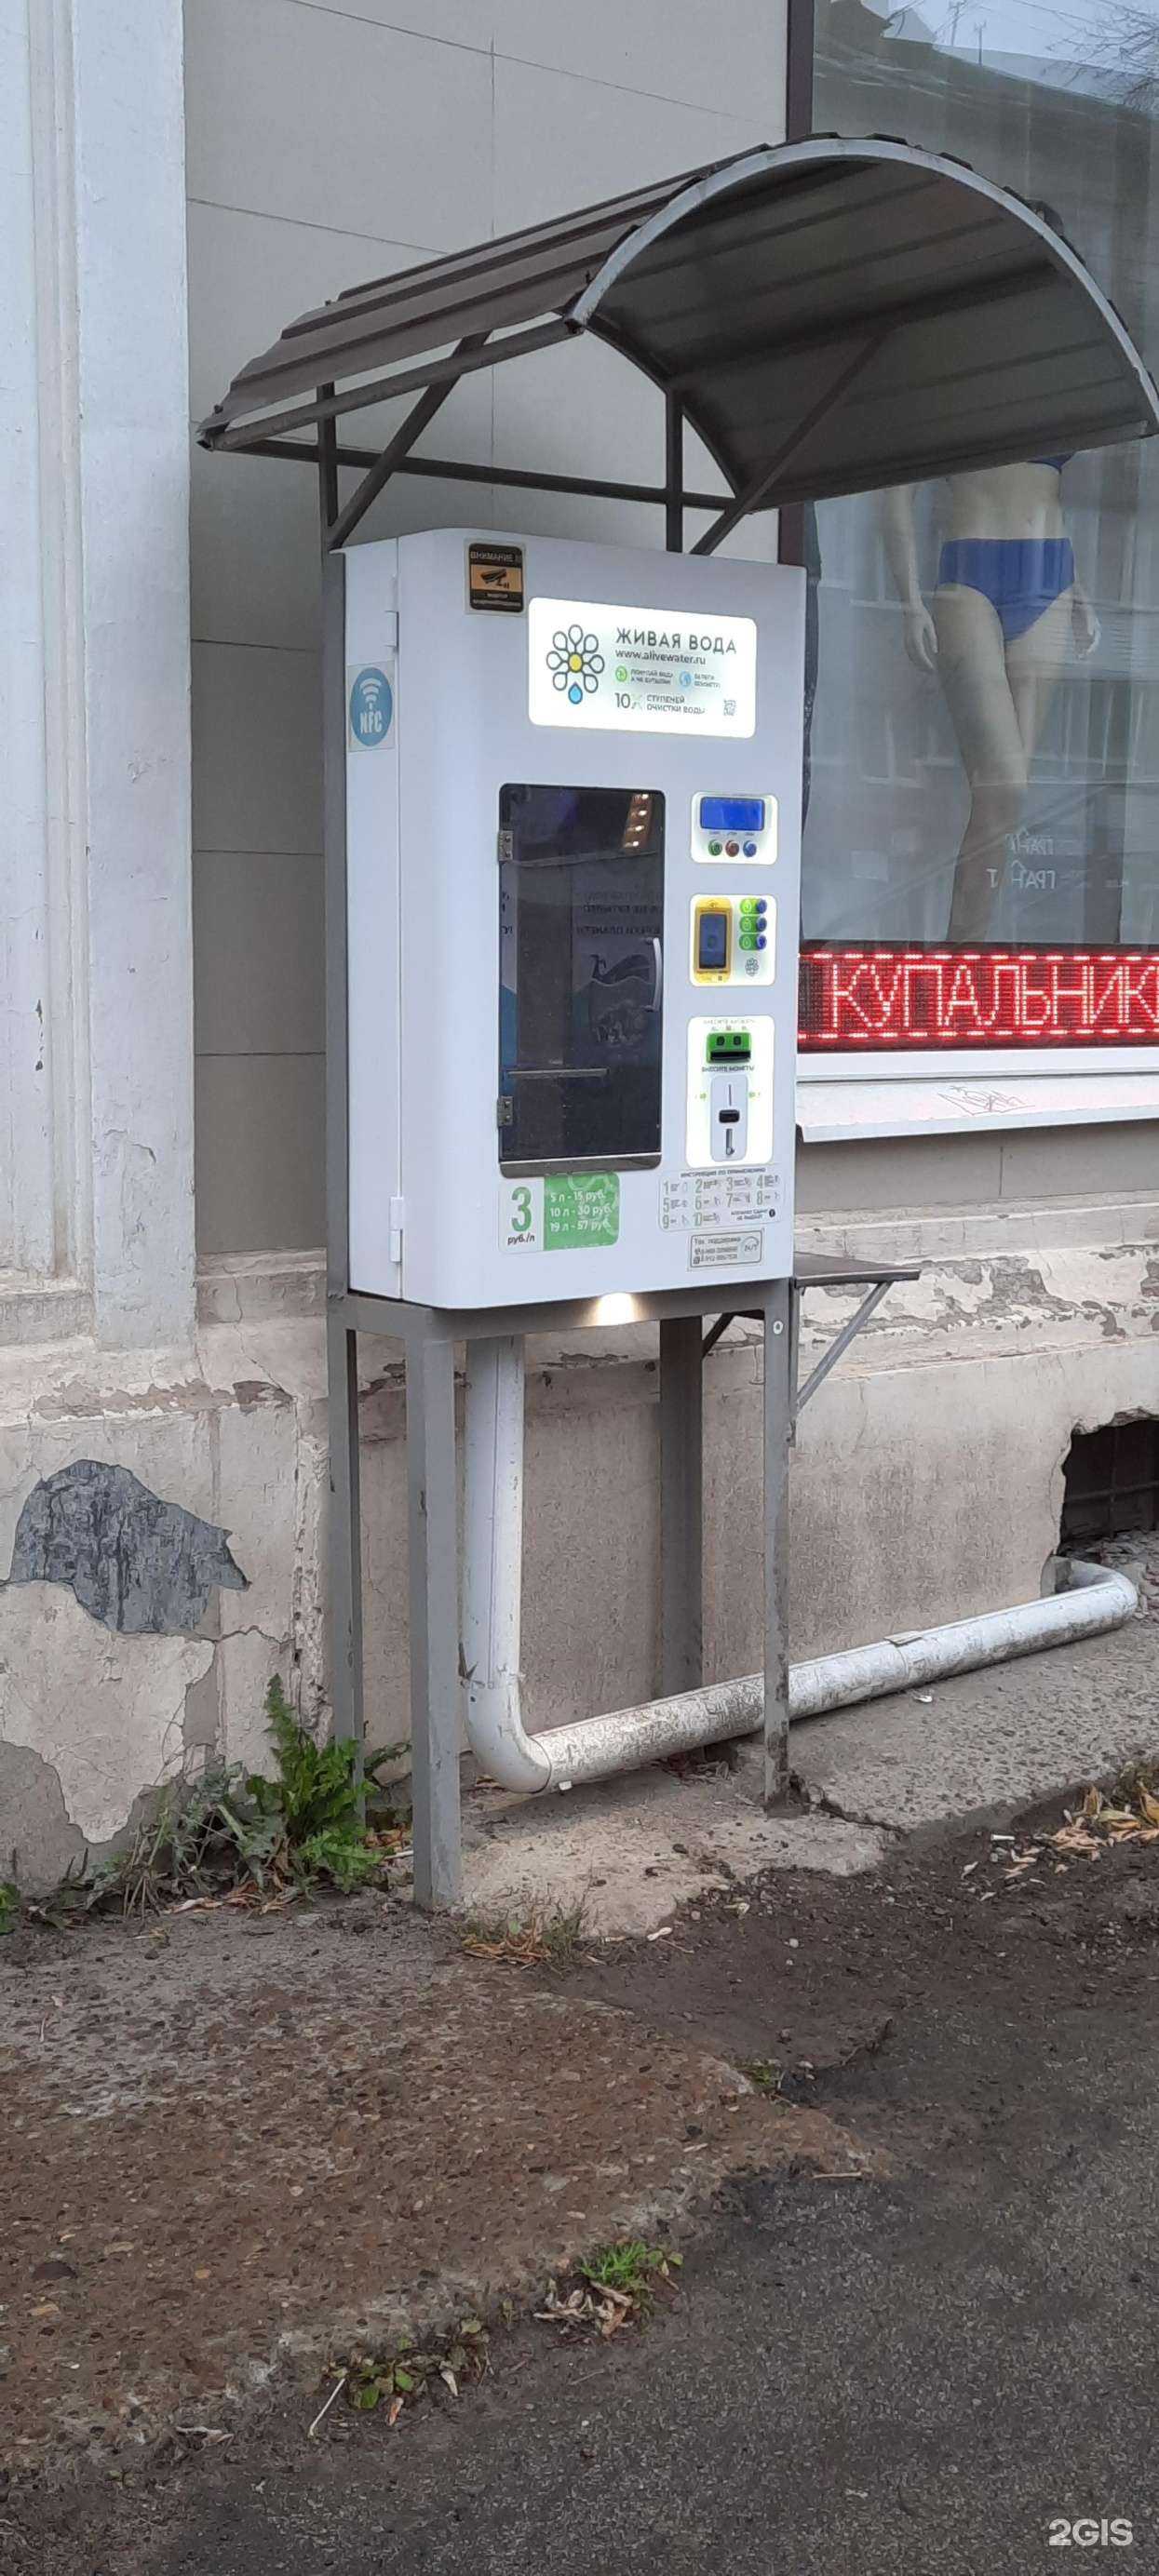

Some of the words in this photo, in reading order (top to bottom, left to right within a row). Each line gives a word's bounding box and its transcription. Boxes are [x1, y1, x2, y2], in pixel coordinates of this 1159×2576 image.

[615, 627, 681, 649] ЖИВАЯ
[689, 635, 737, 655] ВОДА
[615, 650, 707, 665] www.alivewater.ru
[614, 692, 631, 709] 10
[647, 694, 685, 704] СТУПЕНЕЙ
[647, 704, 681, 713] ОЧИСТКИ
[359, 710, 383, 735] NFC
[833, 963, 1159, 1028] КУПАЛЬНИК
[511, 1186, 532, 1233] 3
